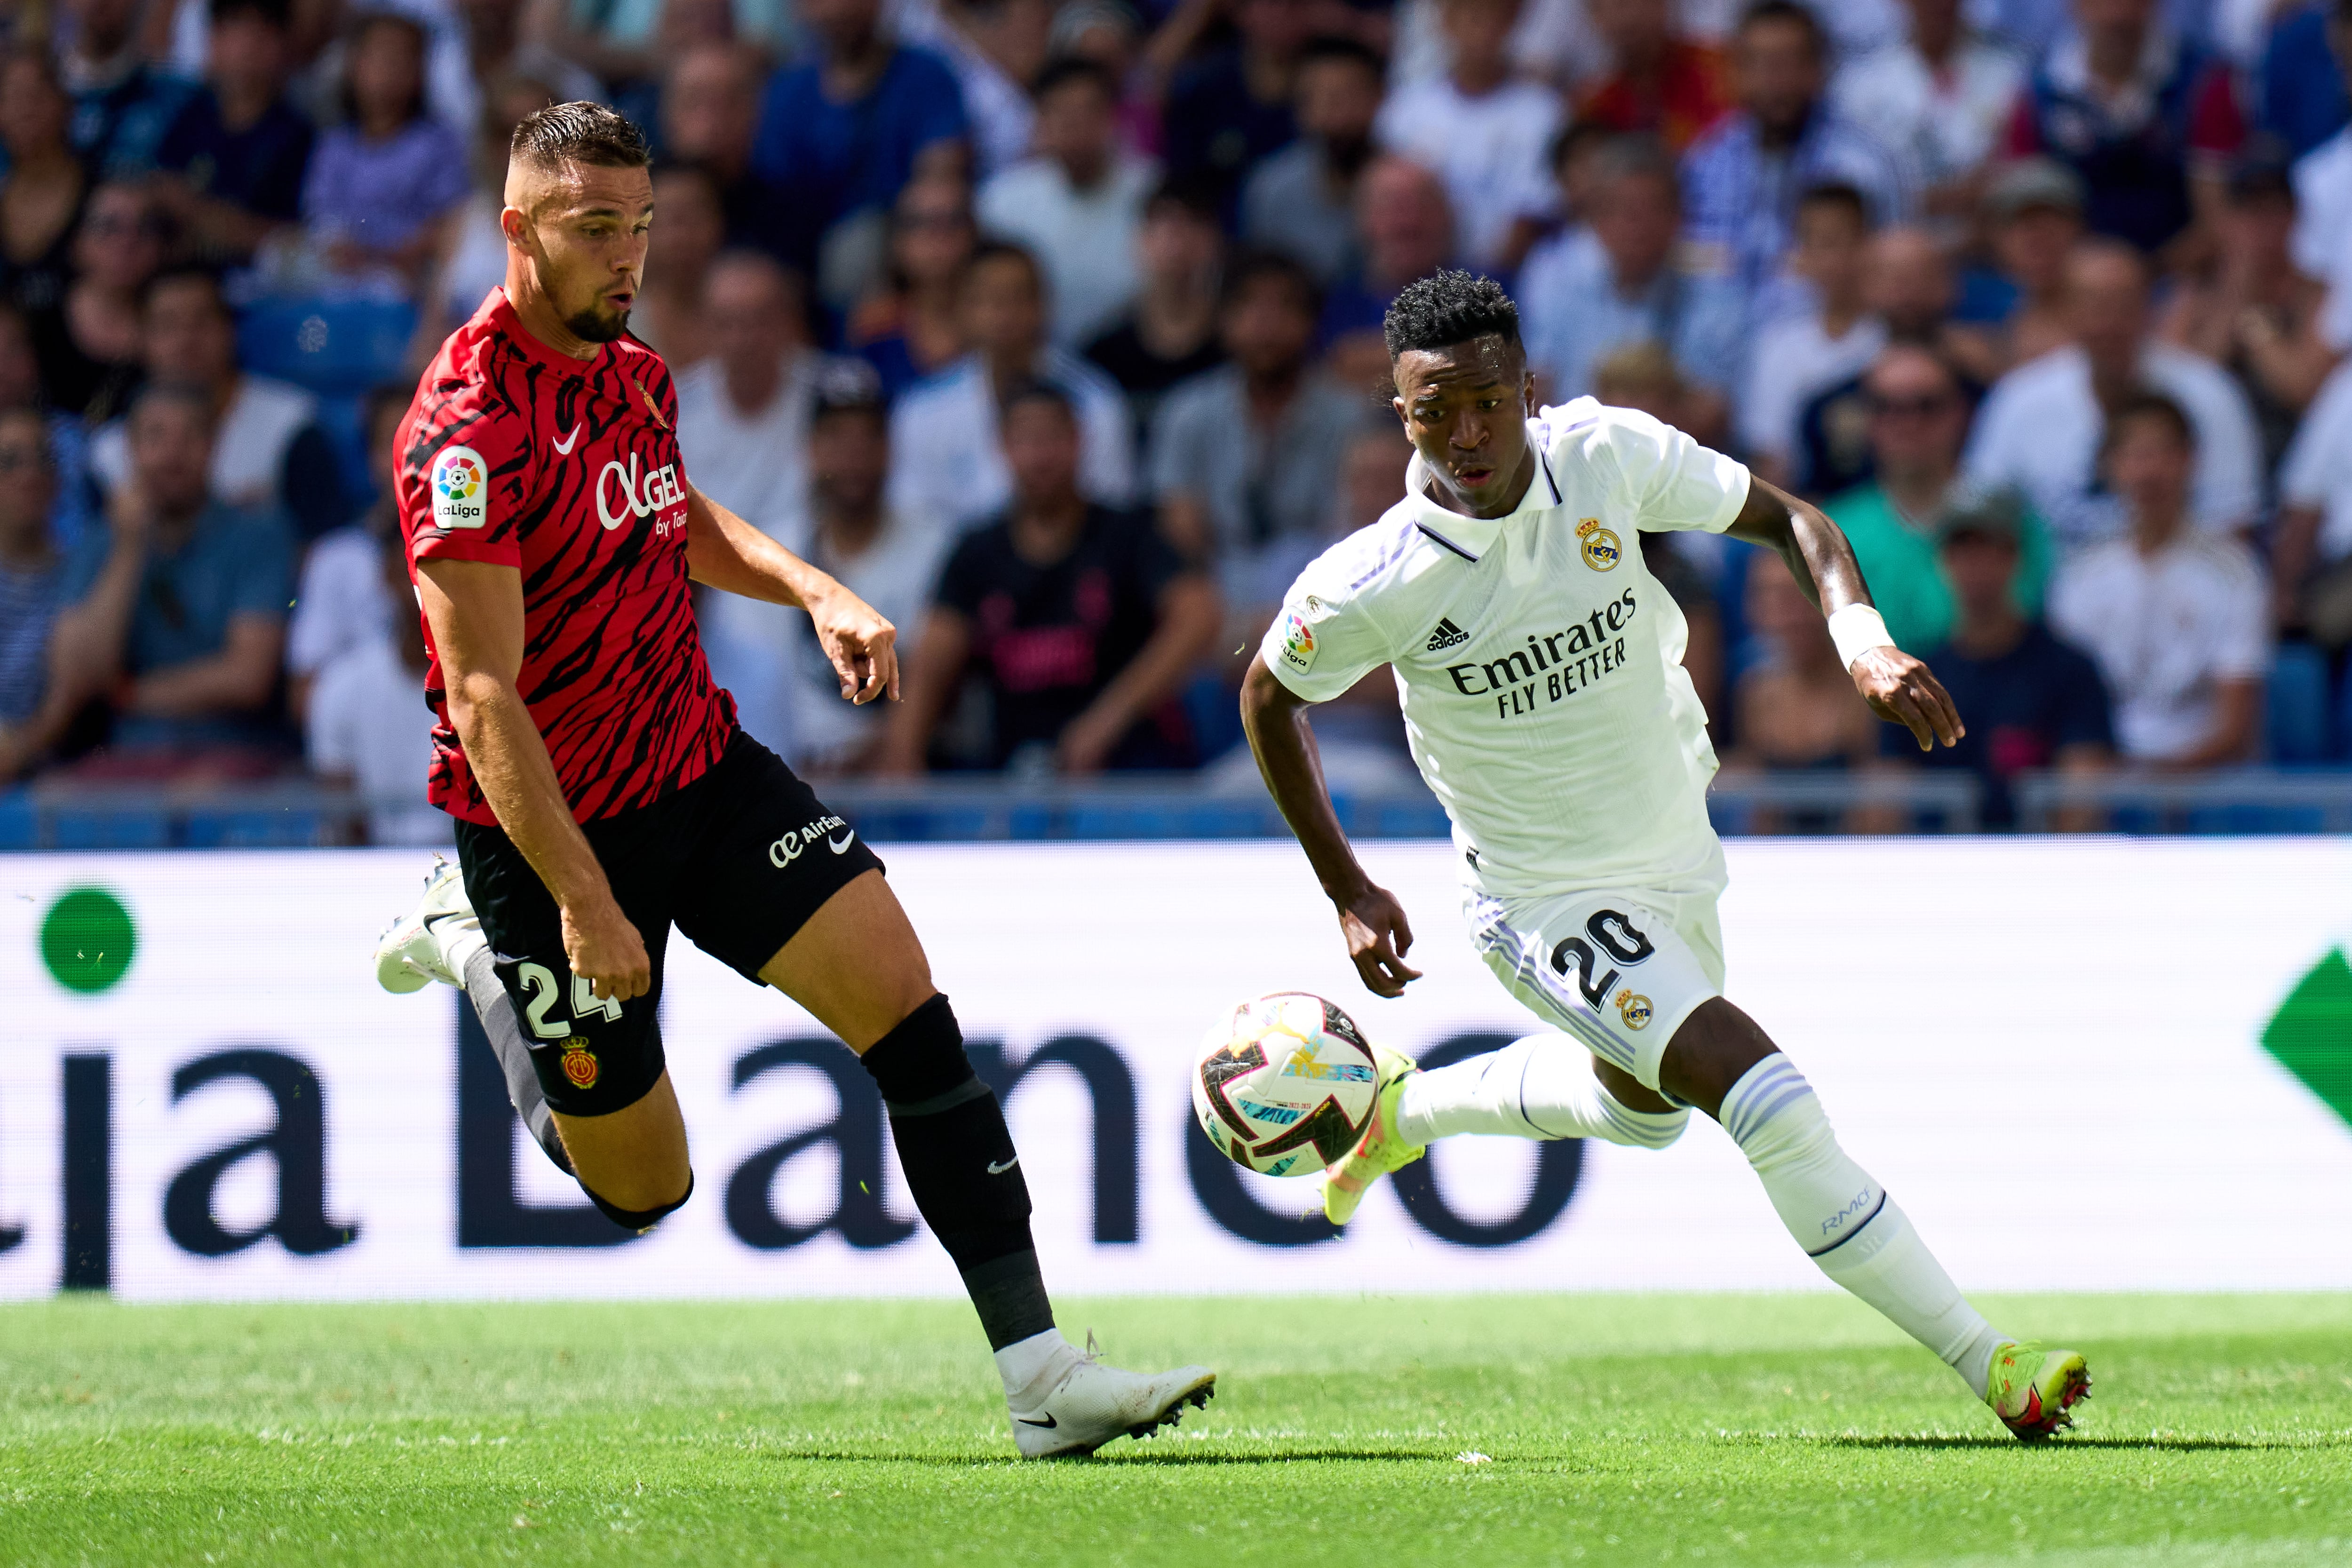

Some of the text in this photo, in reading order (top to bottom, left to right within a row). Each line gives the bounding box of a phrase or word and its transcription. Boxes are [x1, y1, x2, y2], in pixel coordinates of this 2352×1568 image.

[438, 504, 480, 518] LaLiga
[656, 517, 670, 537] by
[1279, 640, 1307, 667] aLiga
[1427, 630, 1470, 651] adidas
[1446, 587, 1636, 695] Emirates
[1497, 637, 1626, 719] FLY BETTER
[1549, 909, 1655, 1014] 20
[518, 962, 623, 1038] 24
[0, 888, 361, 1293] ja
